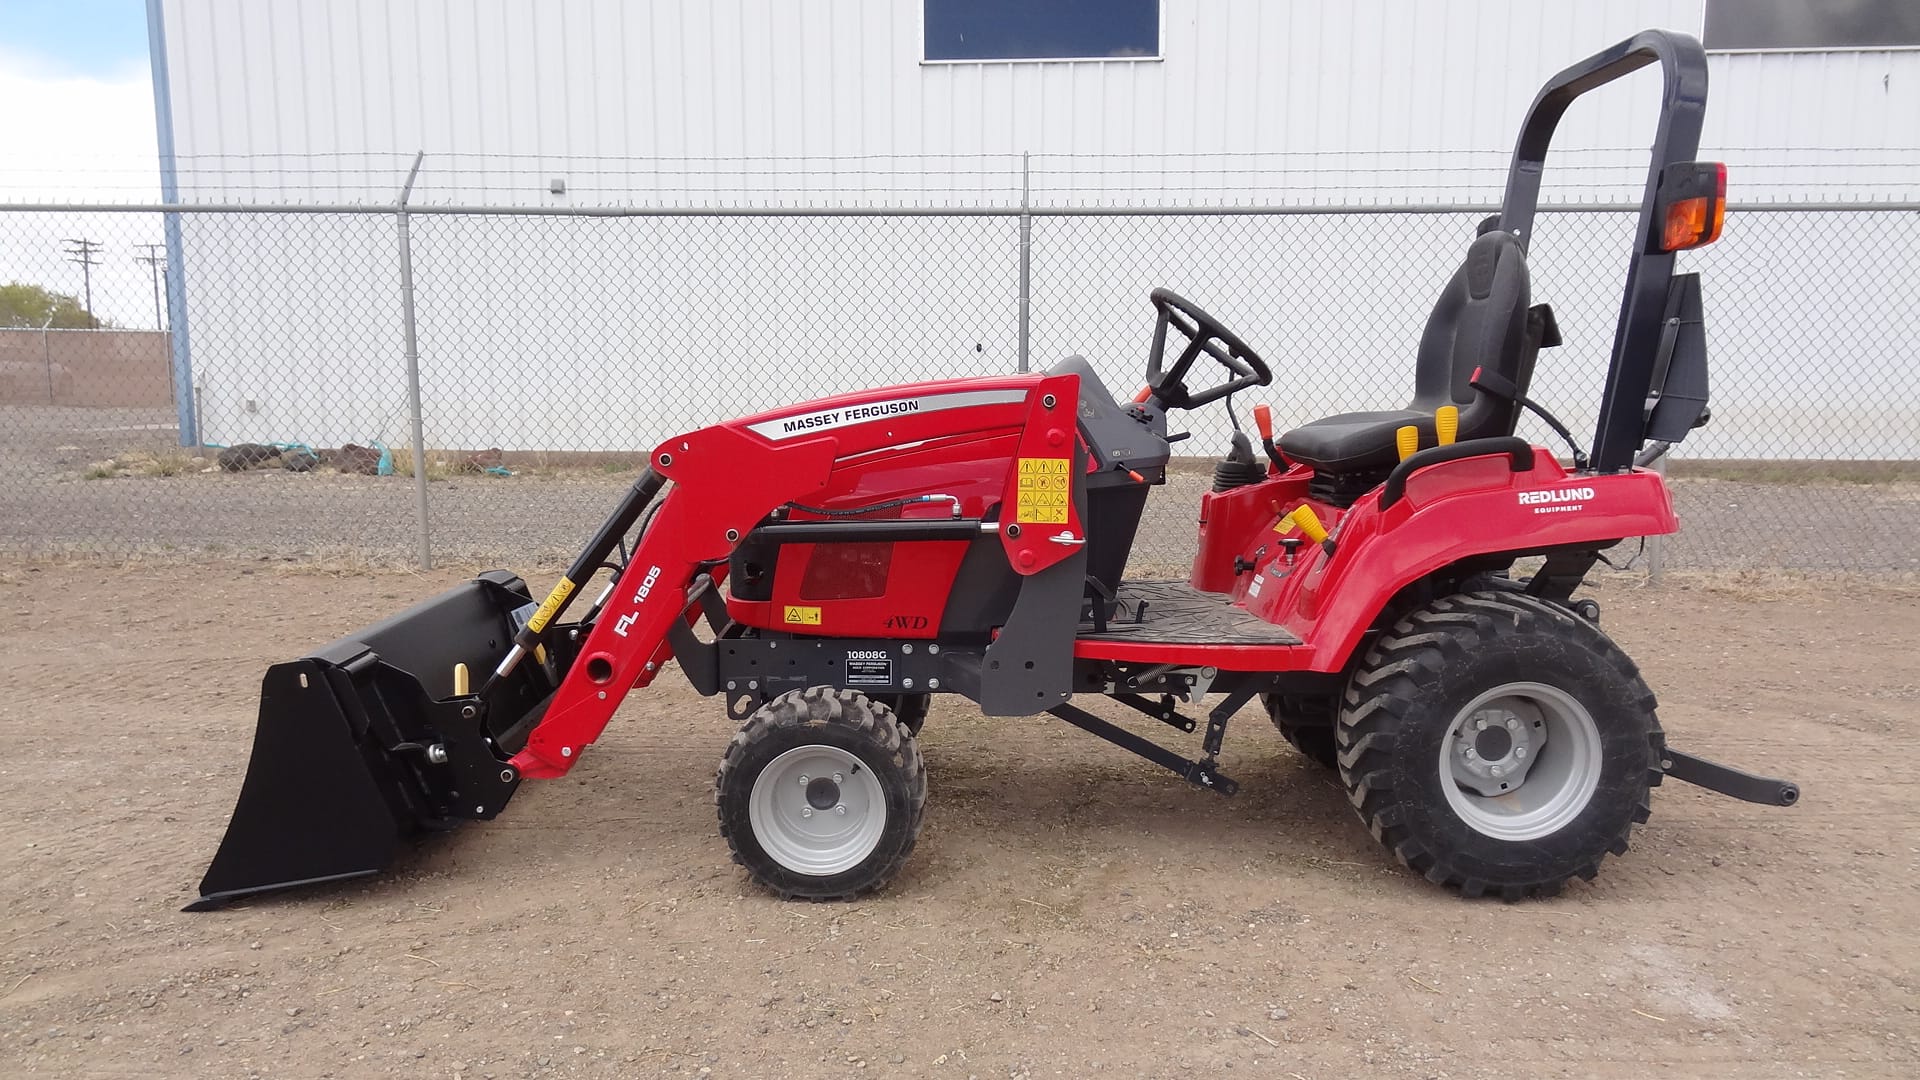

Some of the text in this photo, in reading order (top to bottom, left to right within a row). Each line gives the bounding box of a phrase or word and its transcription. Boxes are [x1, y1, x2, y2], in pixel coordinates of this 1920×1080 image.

[783, 400, 919, 433] MASSEY FERGUSON
[1518, 487, 1595, 505] REDLUND
[1534, 505, 1583, 514] EQUIPMENT
[614, 565, 662, 638] FL 1805
[883, 615, 929, 630] 4WD
[847, 650, 887, 660] 10808G
